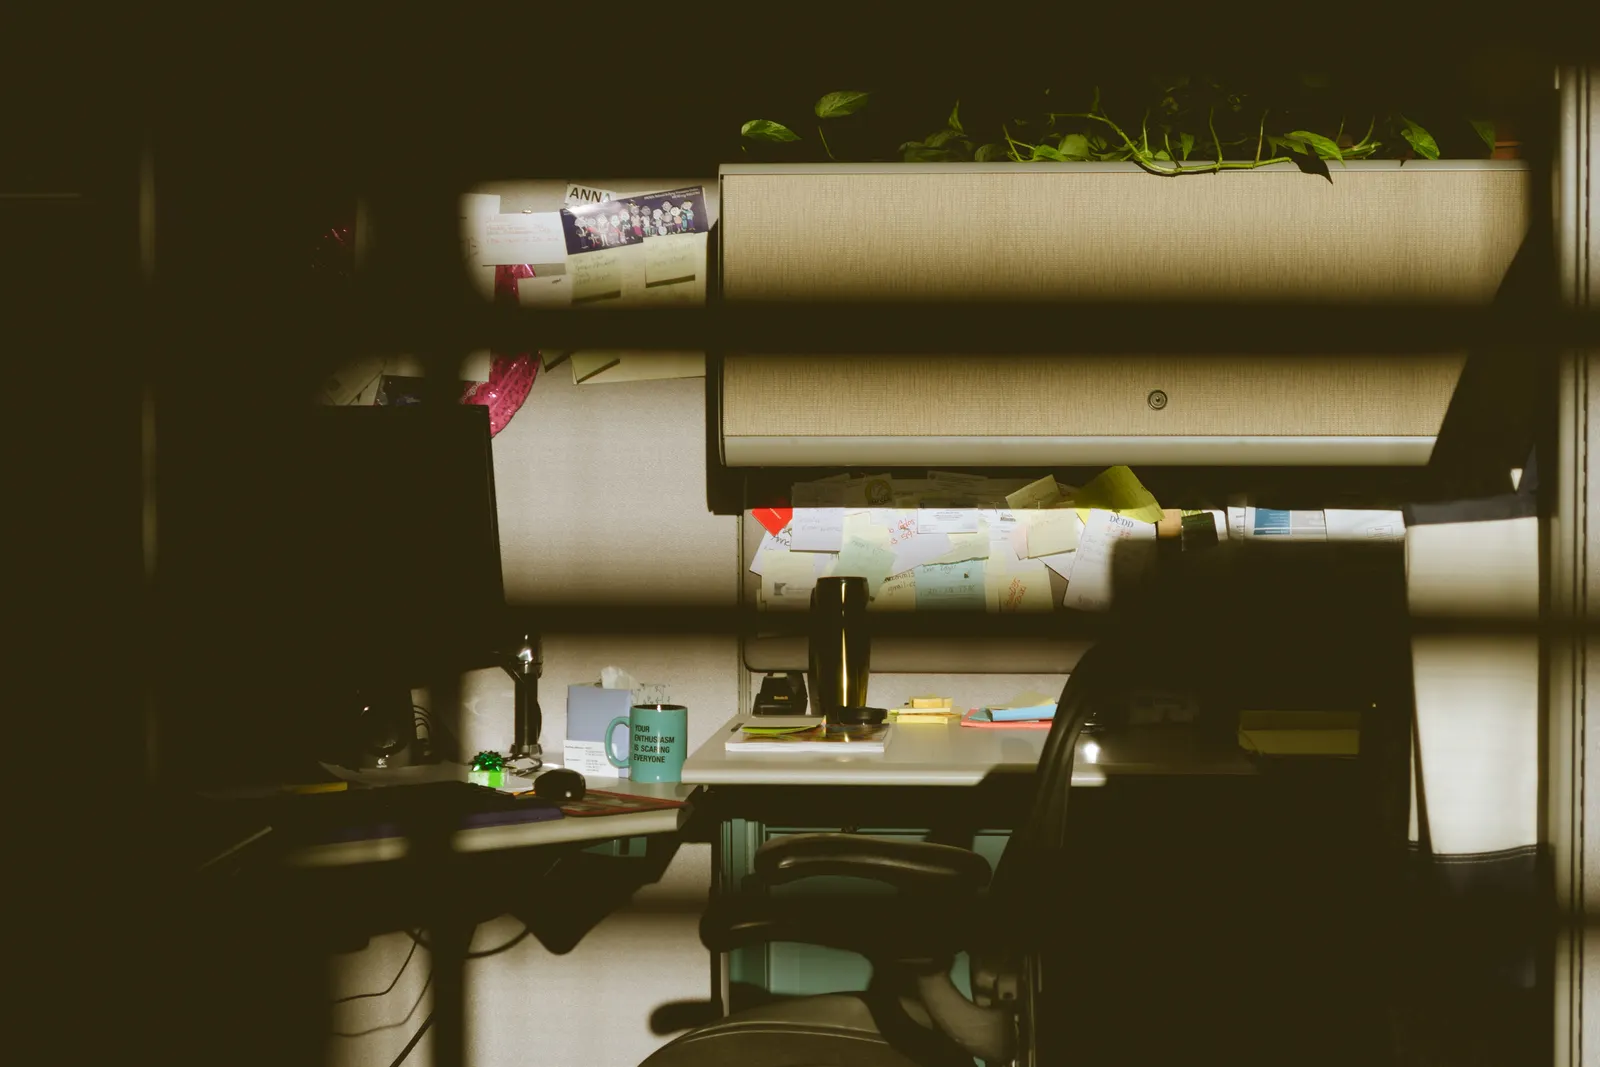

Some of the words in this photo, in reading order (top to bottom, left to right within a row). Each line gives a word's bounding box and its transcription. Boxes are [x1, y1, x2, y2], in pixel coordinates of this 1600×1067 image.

[635, 724, 650, 732] YOUR
[634, 735, 675, 743] ENTHUSASM
[640, 745, 670, 753] SCARNG
[633, 754, 665, 763] EVERYONE
